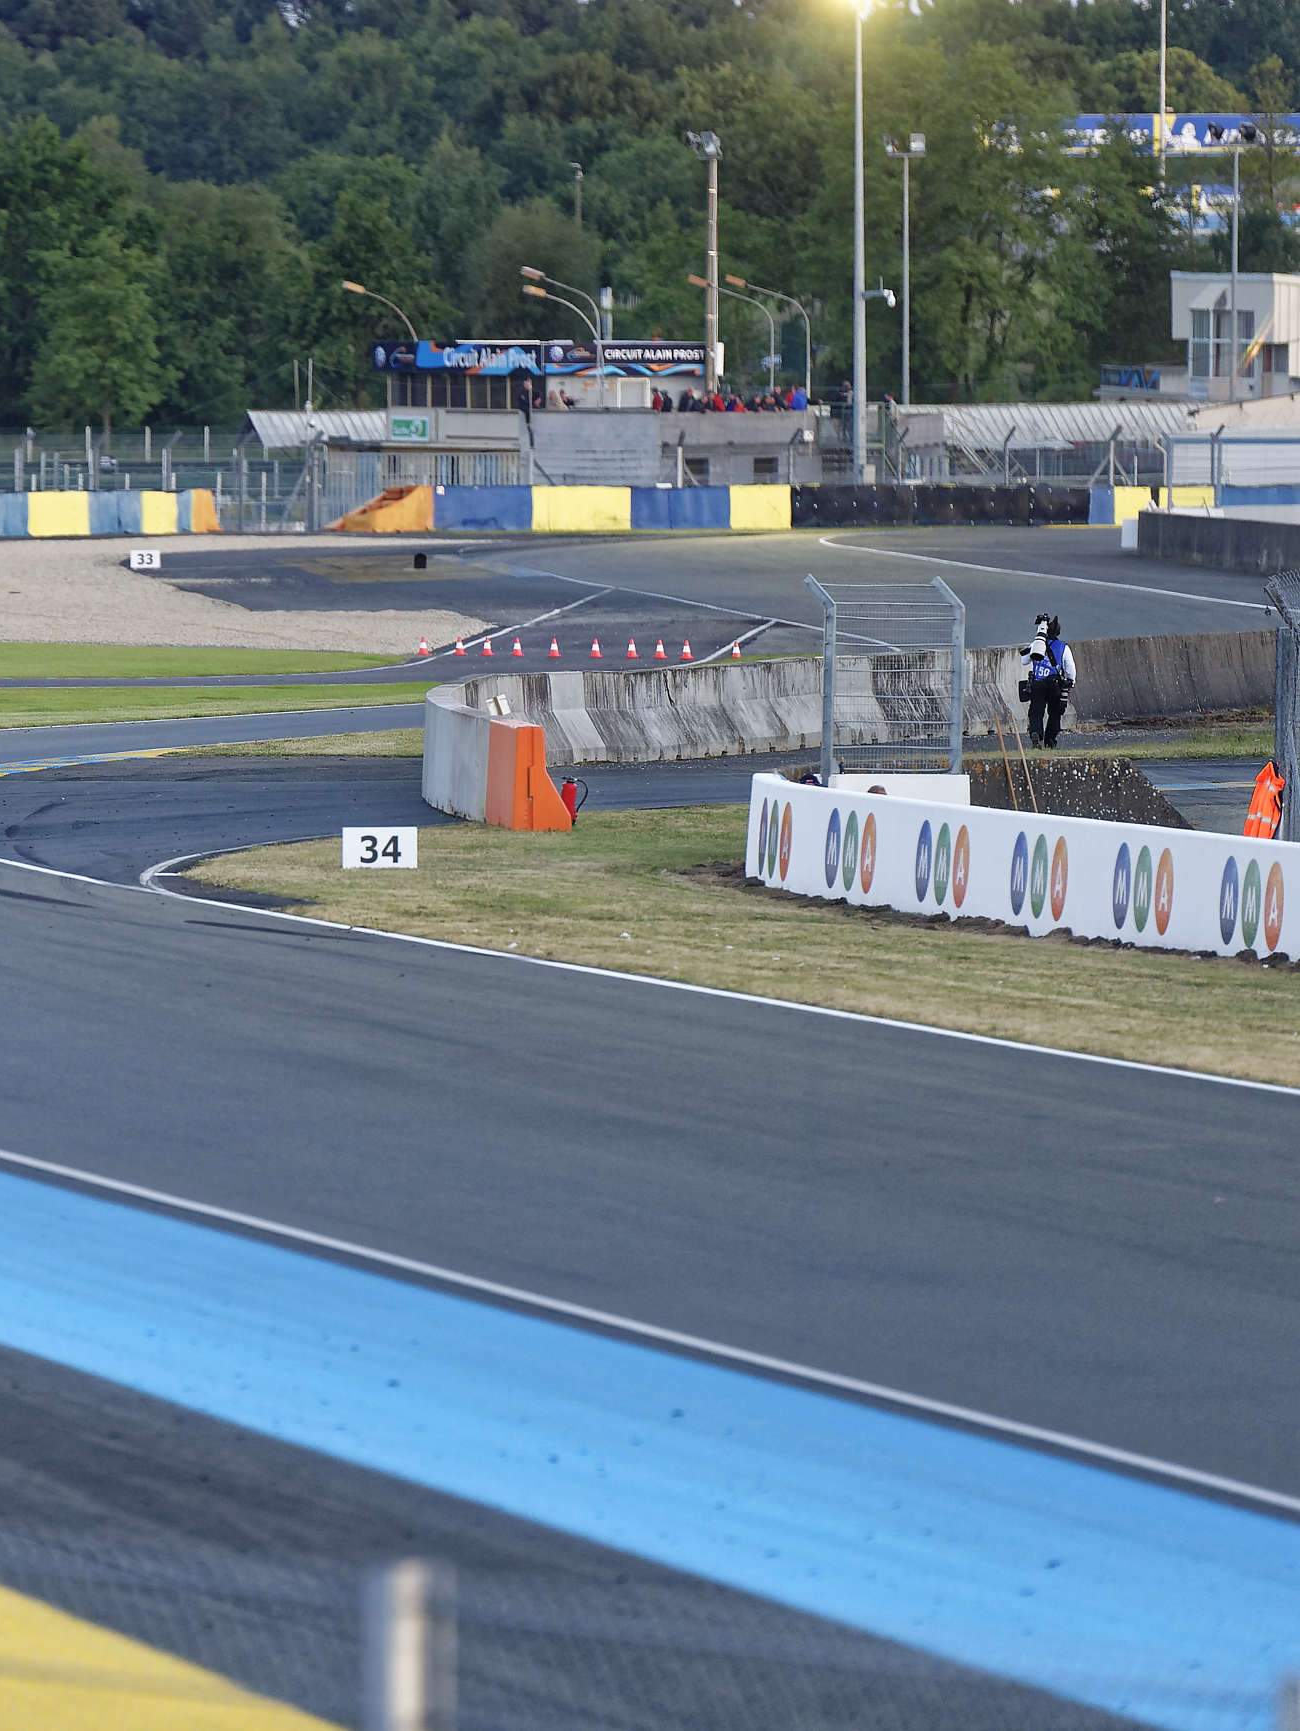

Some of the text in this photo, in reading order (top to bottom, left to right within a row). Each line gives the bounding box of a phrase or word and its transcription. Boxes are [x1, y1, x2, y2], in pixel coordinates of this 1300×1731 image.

[443, 346, 537, 368] Circuit Alain Prost
[604, 349, 705, 360] CIRCUIT ALAIN PROST
[137, 553, 154, 565] 33
[360, 835, 401, 863] 34
